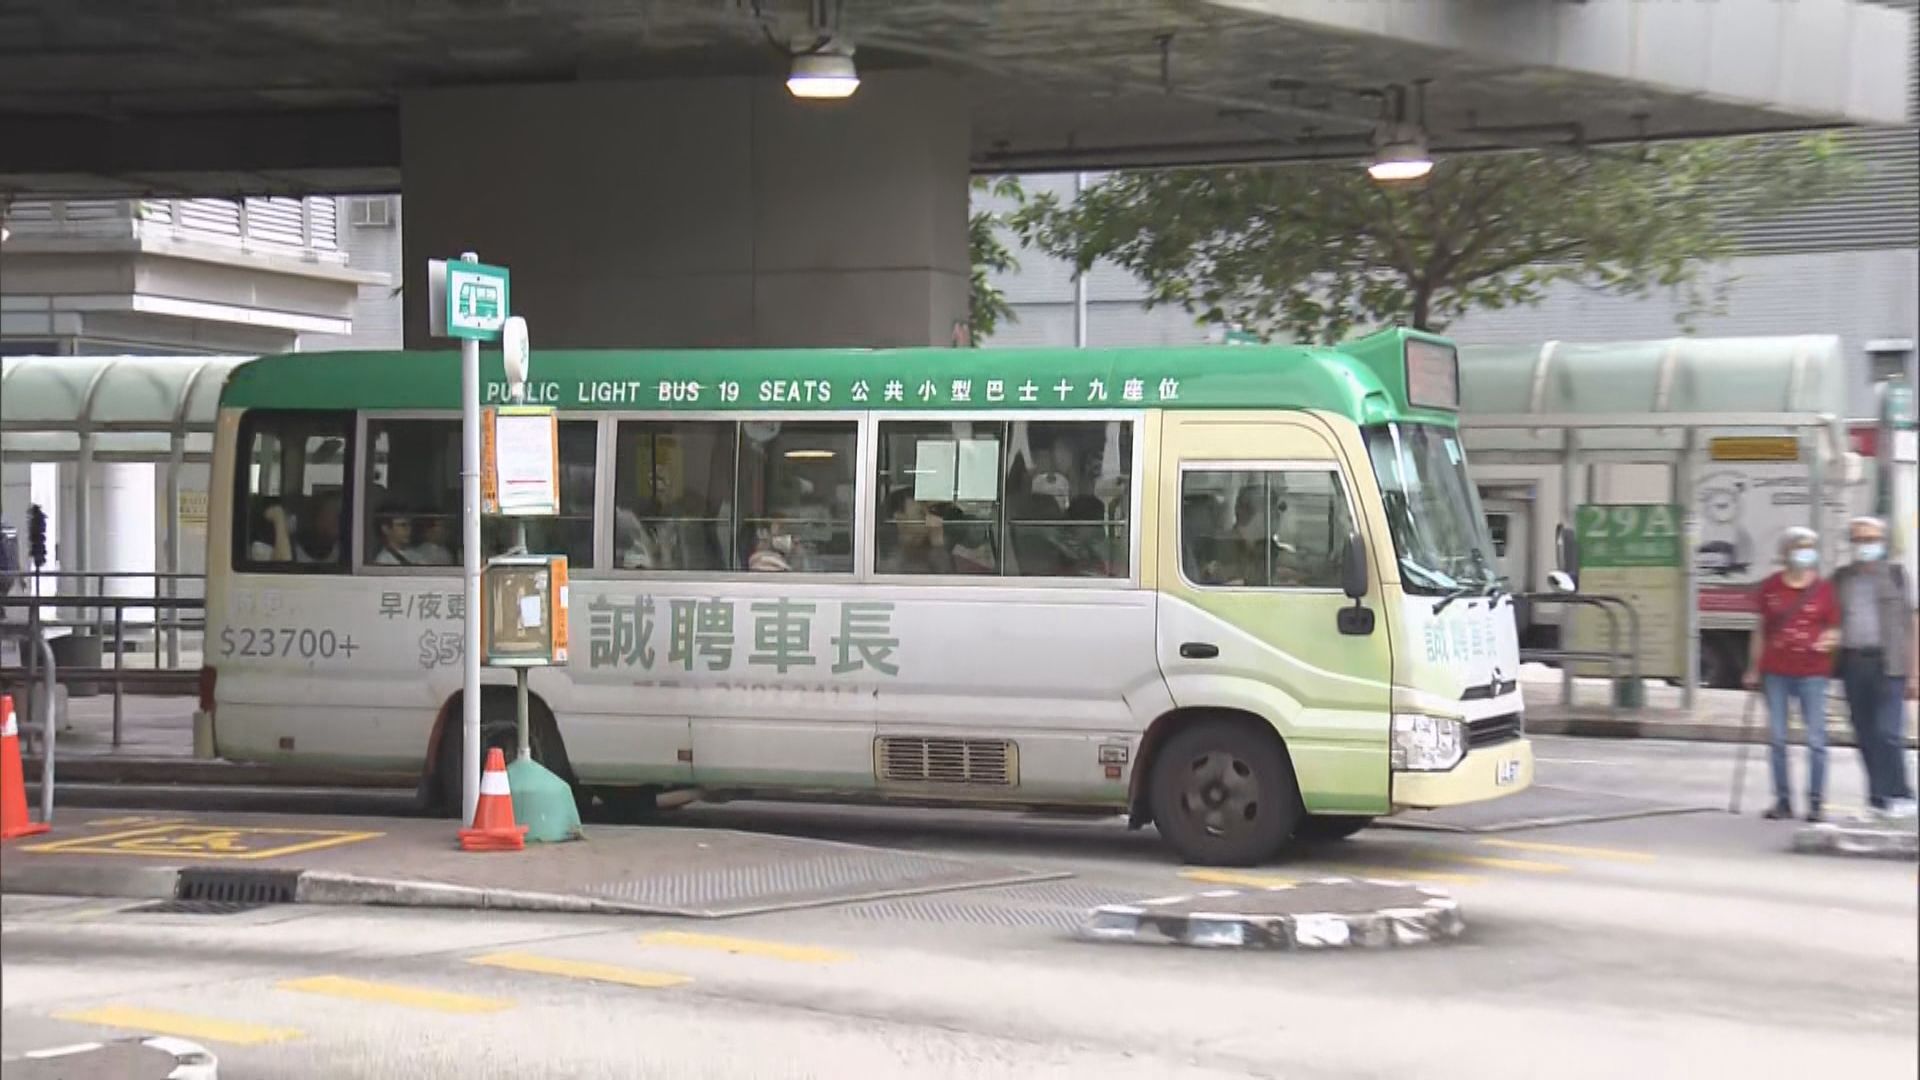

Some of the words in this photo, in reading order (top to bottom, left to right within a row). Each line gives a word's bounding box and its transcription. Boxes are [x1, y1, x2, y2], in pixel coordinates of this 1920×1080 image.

[487, 381, 560, 403] PULIC
[578, 381, 640, 402] LIGHT
[658, 381, 700, 402] BUS
[719, 381, 740, 402] 19
[758, 380, 832, 401] SEATS
[850, 379, 1179, 401] 公共小型巴士十九座位
[1584, 505, 1676, 538] 29A
[219, 625, 360, 659] $23700+
[419, 629, 464, 669] $5
[588, 593, 900, 677] 誠聘車長
